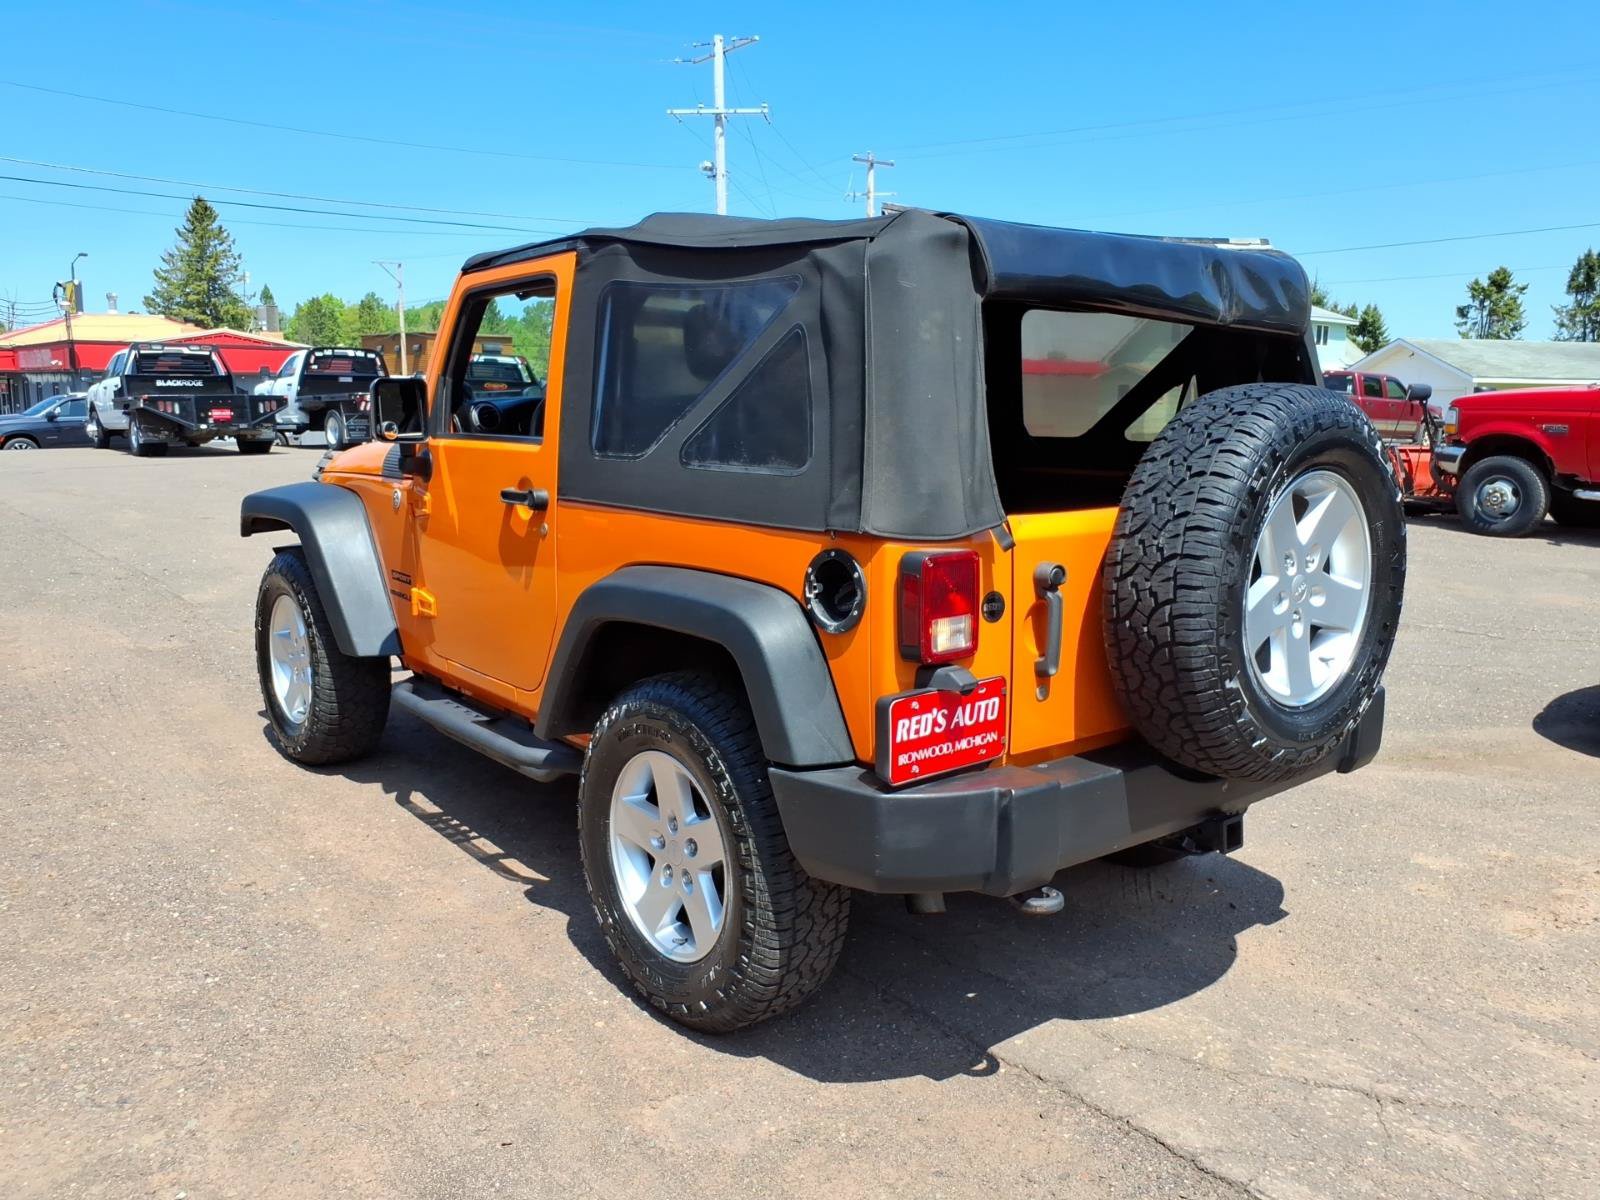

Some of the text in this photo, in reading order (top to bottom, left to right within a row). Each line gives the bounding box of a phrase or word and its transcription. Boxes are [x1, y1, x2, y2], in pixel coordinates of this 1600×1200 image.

[155, 379, 204, 387] BLACKRIDGE
[896, 697, 999, 743] RED'S AUTO
[898, 731, 998, 766] IRONWOOD, MICHIGAN
